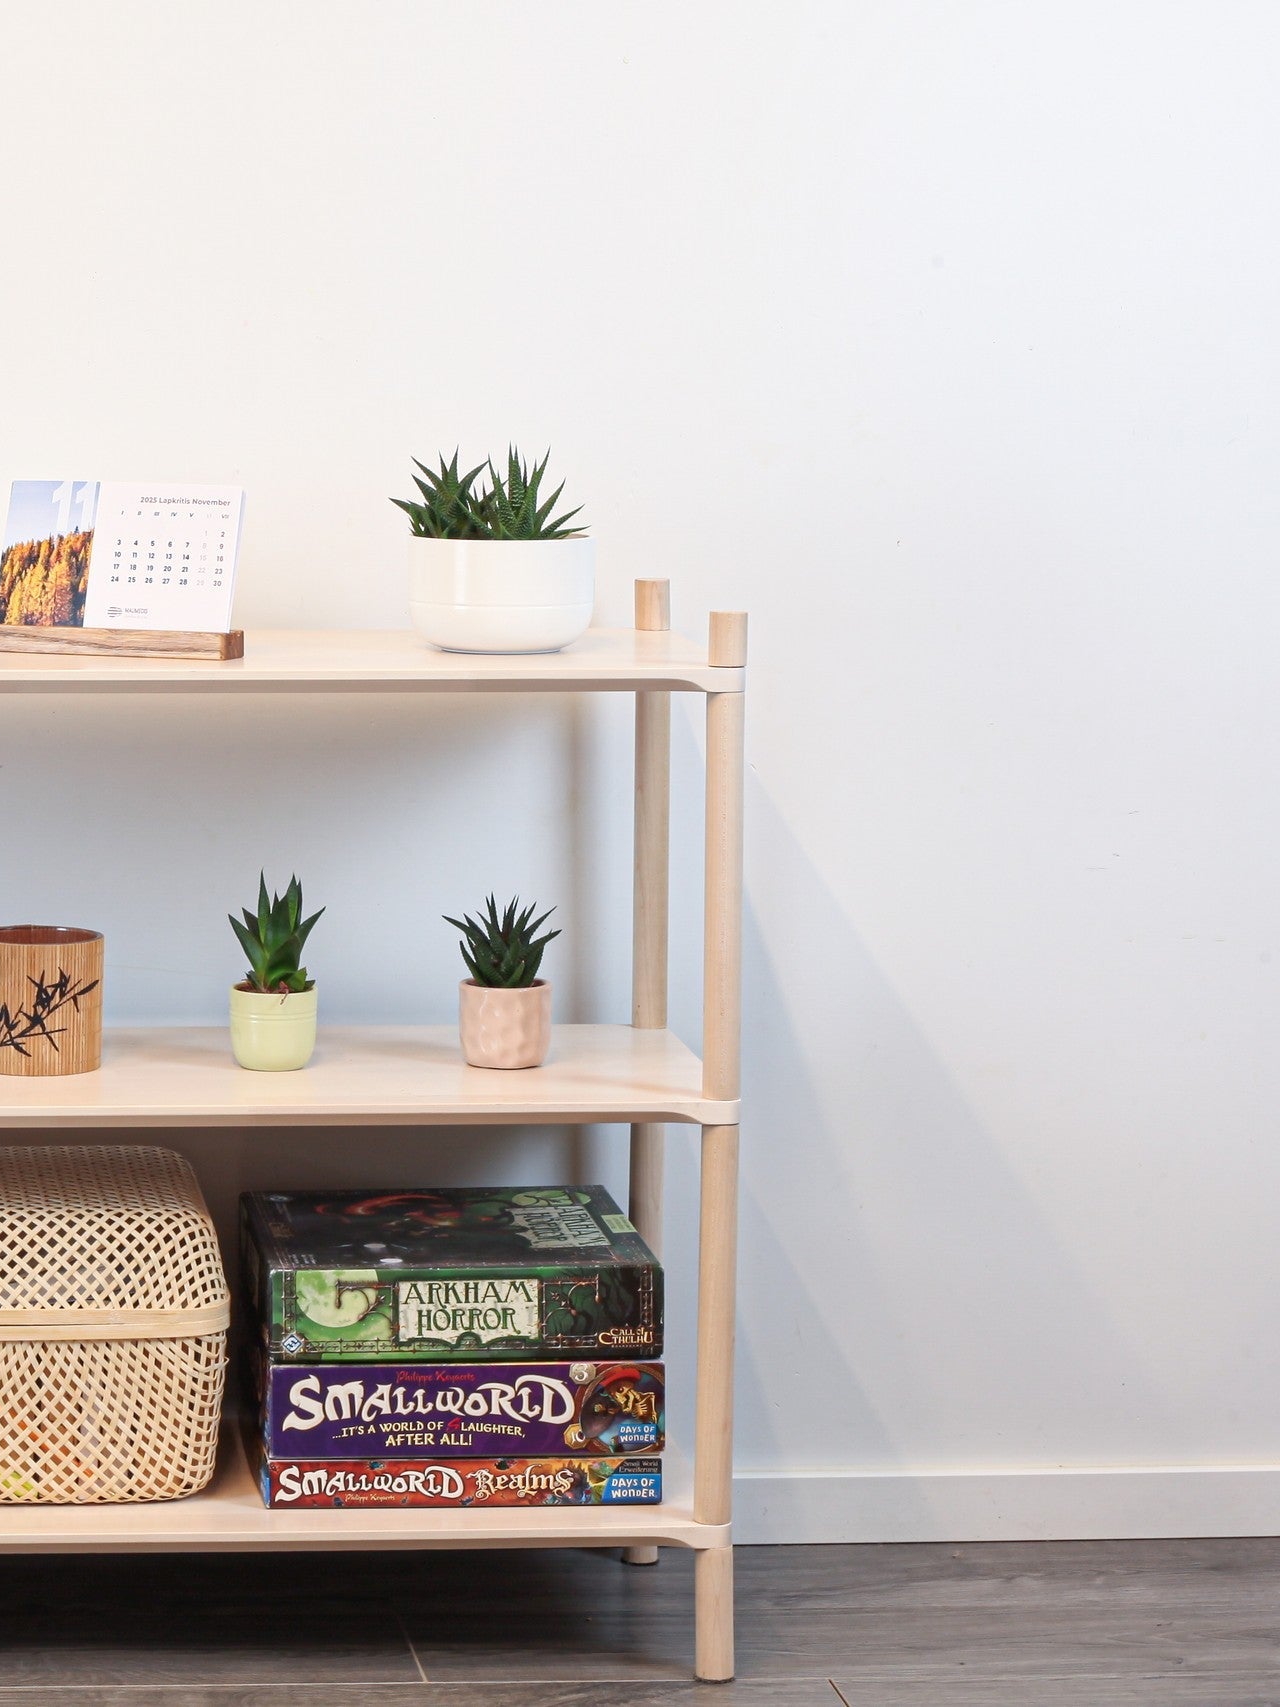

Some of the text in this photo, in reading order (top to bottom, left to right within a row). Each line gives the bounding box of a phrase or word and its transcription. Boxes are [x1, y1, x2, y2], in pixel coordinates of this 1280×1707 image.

[140, 496, 231, 506] 2025 Lapkritis November
[402, 1280, 534, 1309] ARKHAM
[416, 1307, 522, 1337] HORROR
[598, 1331, 654, 1345] CTHULHU
[610, 1328, 635, 1336] CALL
[367, 1424, 376, 1434] A
[379, 1420, 424, 1433] WORLD
[427, 1421, 444, 1431] OF
[620, 1425, 655, 1434] DAYS OF
[385, 1433, 472, 1447] AFTER ALL!
[465, 1464, 575, 1501] Realms
[611, 1477, 655, 1487] DAYS OF
[611, 1488, 655, 1498] WONDER
